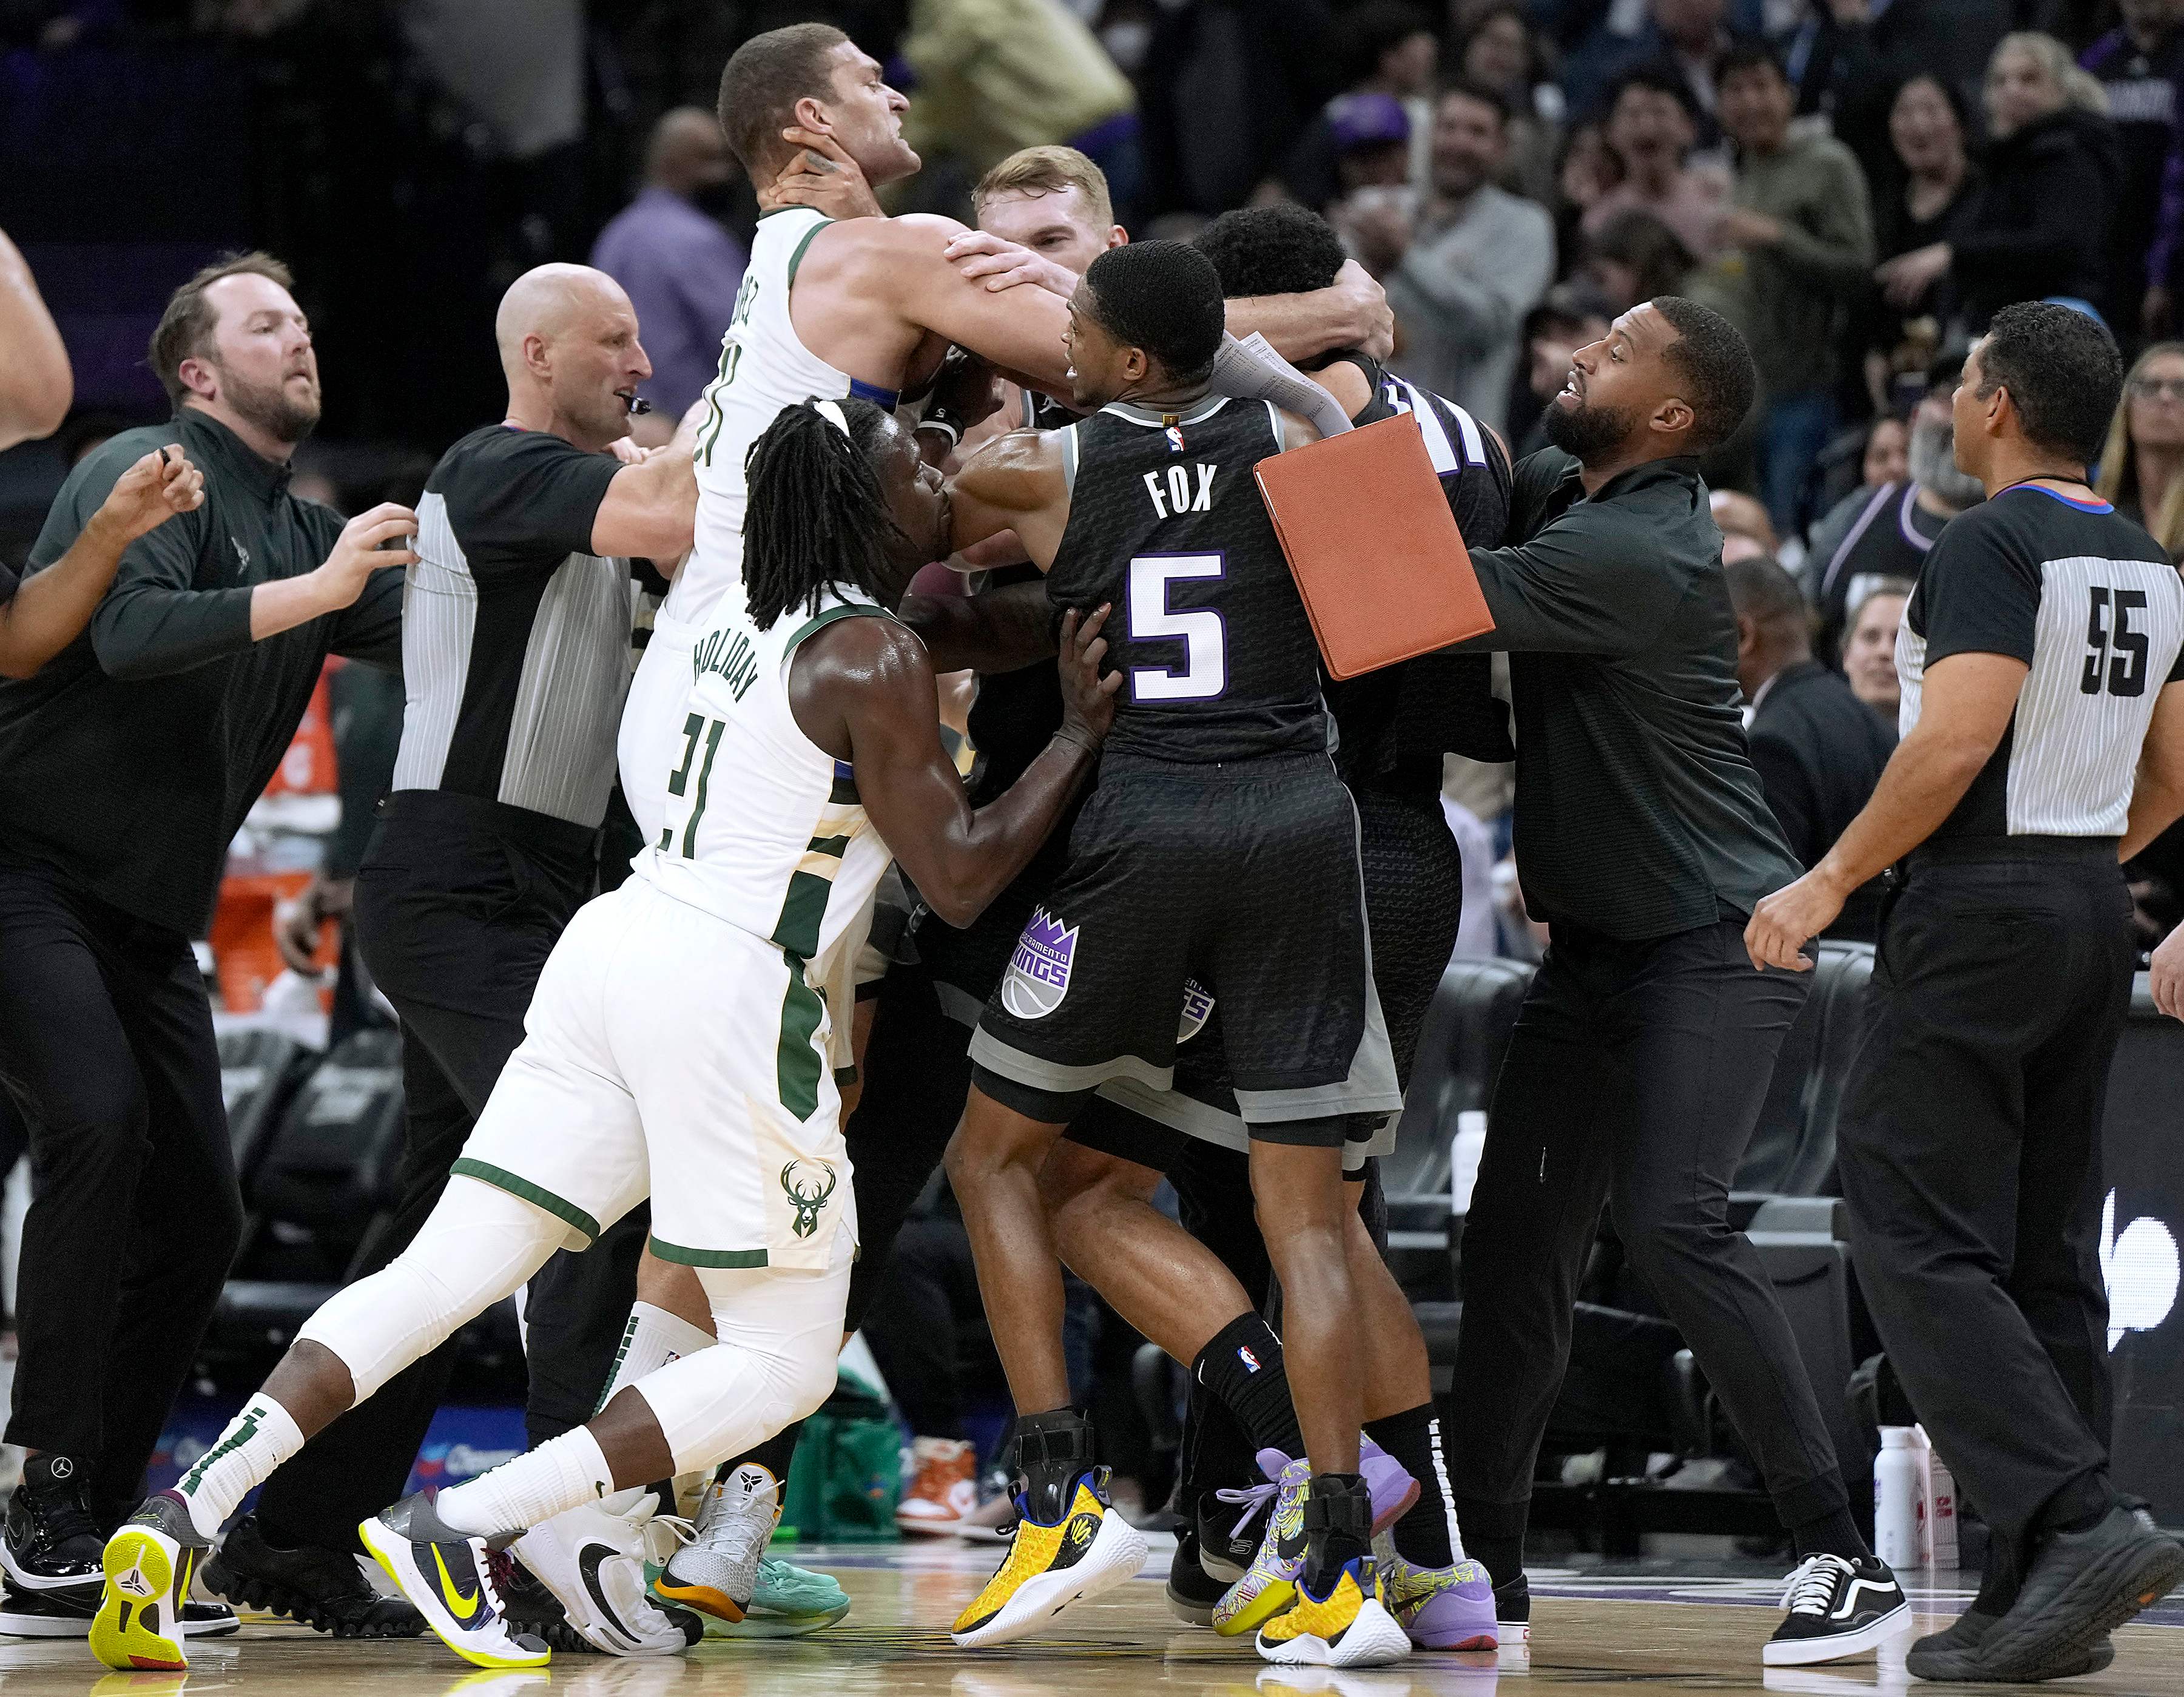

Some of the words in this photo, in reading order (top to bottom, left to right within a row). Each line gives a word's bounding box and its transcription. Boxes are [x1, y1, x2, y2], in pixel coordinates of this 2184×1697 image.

[1143, 464, 1218, 519] FOX
[1127, 552, 1227, 703] 5
[2080, 586, 2149, 697] 55
[693, 628, 758, 703] HOLIDAY
[1011, 943, 1068, 989] KINGS
[1020, 931, 1068, 963] SACRAMENTO
